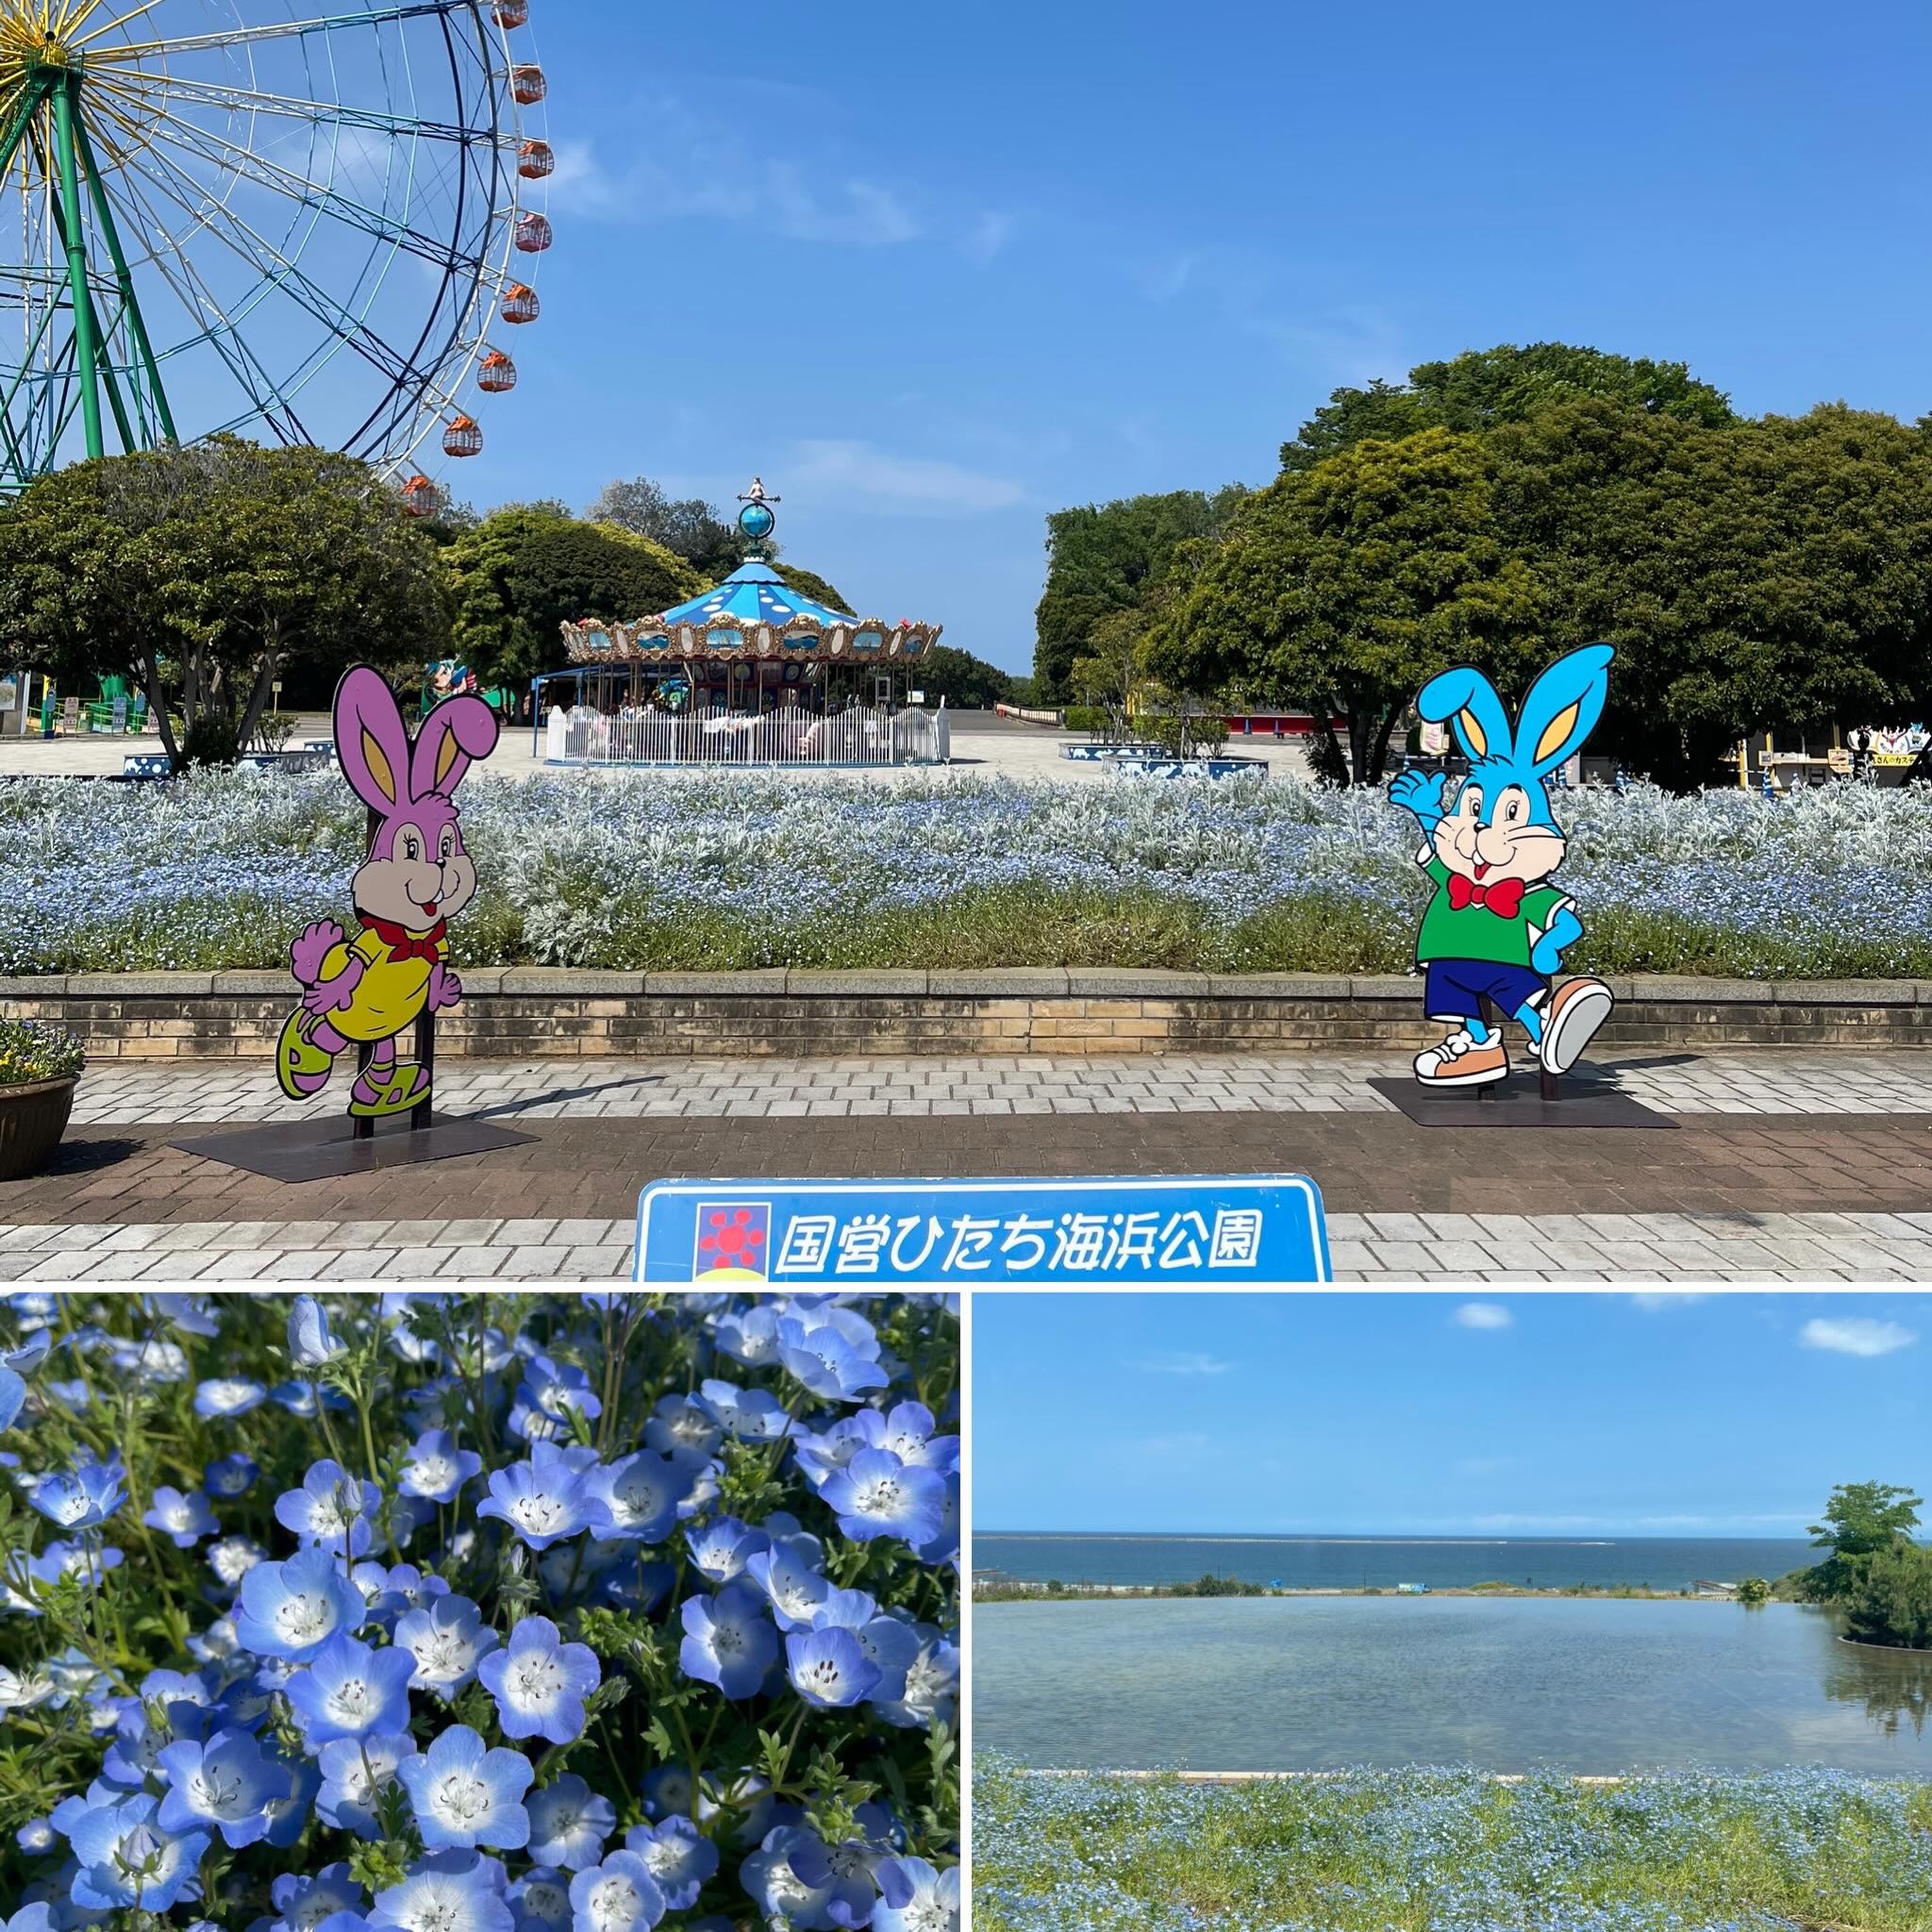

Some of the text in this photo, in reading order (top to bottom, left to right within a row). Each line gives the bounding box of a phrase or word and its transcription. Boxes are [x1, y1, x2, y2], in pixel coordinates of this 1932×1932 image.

[775, 1208, 1263, 1274] 国営ひたち海浜公園
